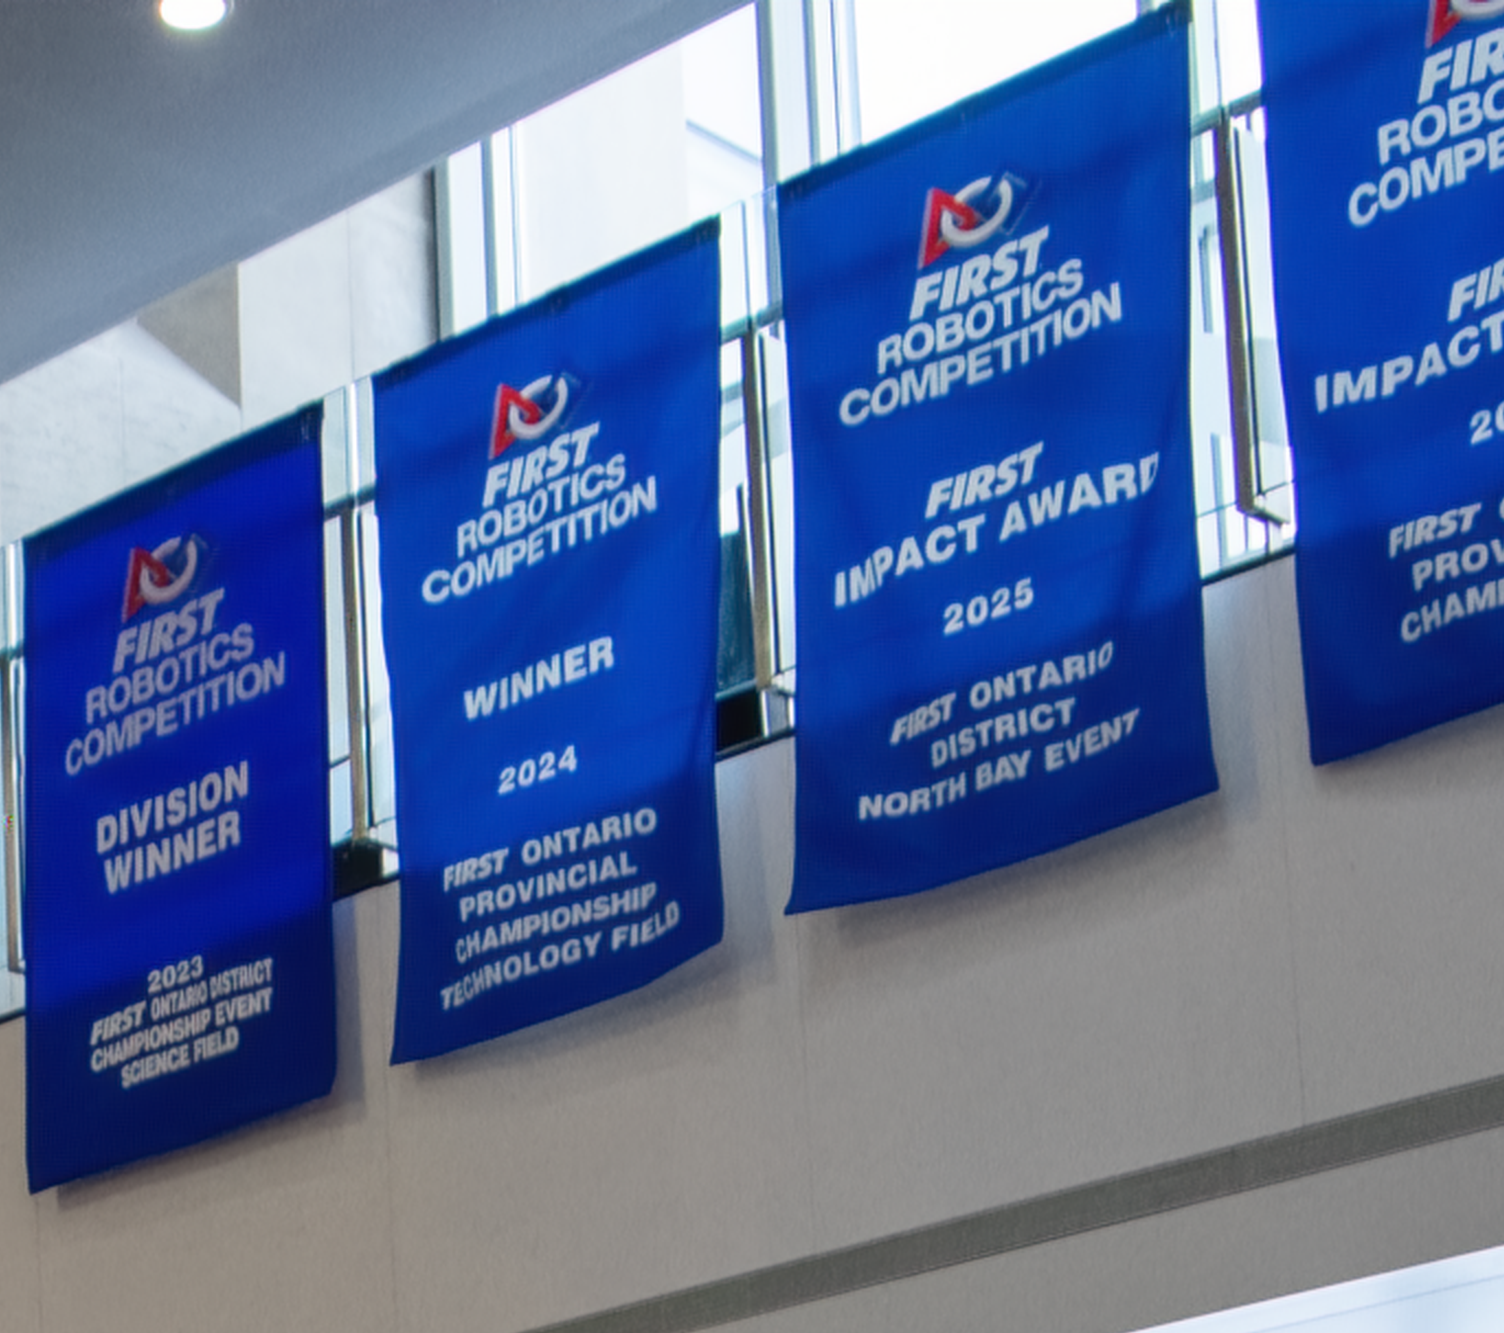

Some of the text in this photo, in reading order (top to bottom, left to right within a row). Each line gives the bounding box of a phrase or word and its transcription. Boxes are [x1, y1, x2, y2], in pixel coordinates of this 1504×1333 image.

[877, 258, 1084, 375] ROBOTICS
[909, 225, 1049, 321] FIRST
[839, 282, 1122, 426] COMPETITION
[456, 453, 626, 558] ROBOTICS
[483, 421, 600, 508] FIRST
[925, 441, 1044, 519] FIRST
[422, 475, 657, 604] COMPETITION
[835, 451, 1159, 609] IMPACT AWARD
[1388, 502, 1481, 558] FIRST
[113, 587, 225, 674] FIRST
[943, 577, 1034, 636] 2025
[65, 650, 286, 776] COMPETITION
[86, 622, 255, 724] ROBOTICS
[463, 636, 614, 721] WINNER
[890, 641, 1113, 746] FIRST ONTARIO
[498, 745, 578, 795] 2024
[858, 708, 1140, 820] NORTH BAY EVENT
[931, 697, 1075, 768] DISTRICT
[97, 760, 248, 854] DIVISION
[443, 807, 657, 893] FIRST ONTARIO
[104, 810, 240, 894] WINNER
[459, 851, 638, 923] PROVINCIAL
[441, 900, 680, 1010] TECHNOLOGY FIELD
[455, 882, 657, 964] CHAMPIONSHIP
[90, 957, 273, 1046] FIRST ONTARIO DISTRICT
[148, 954, 203, 994] 2023
[91, 986, 273, 1073] CHAMPIONSHIP EVENT
[121, 1026, 239, 1089] SCIENCE FIELD
